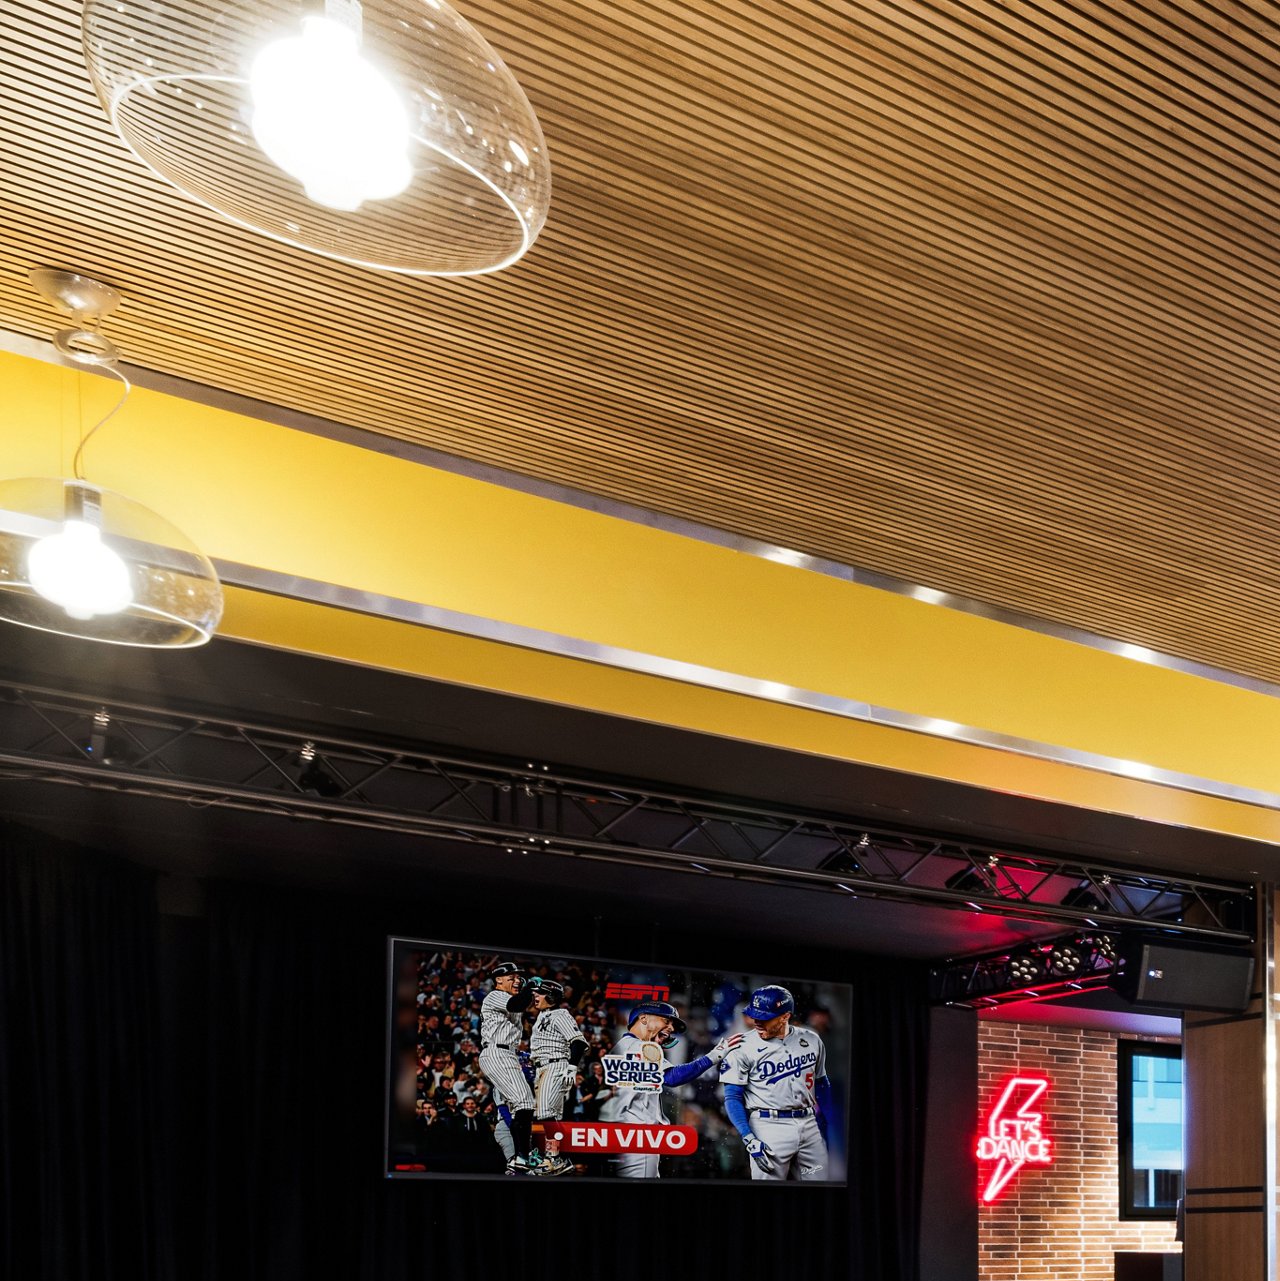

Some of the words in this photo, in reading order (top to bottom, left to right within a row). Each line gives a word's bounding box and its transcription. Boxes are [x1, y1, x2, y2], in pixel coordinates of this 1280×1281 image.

[605, 982, 670, 1002] ESPN
[604, 1058, 659, 1072] WORLD
[757, 1052, 817, 1083] Dodgers
[606, 1070, 662, 1084] SERIES
[804, 1072, 814, 1090] 5
[571, 1127, 608, 1147] EN
[615, 1129, 687, 1149] VIVO
[979, 1137, 1051, 1162] DANCE
